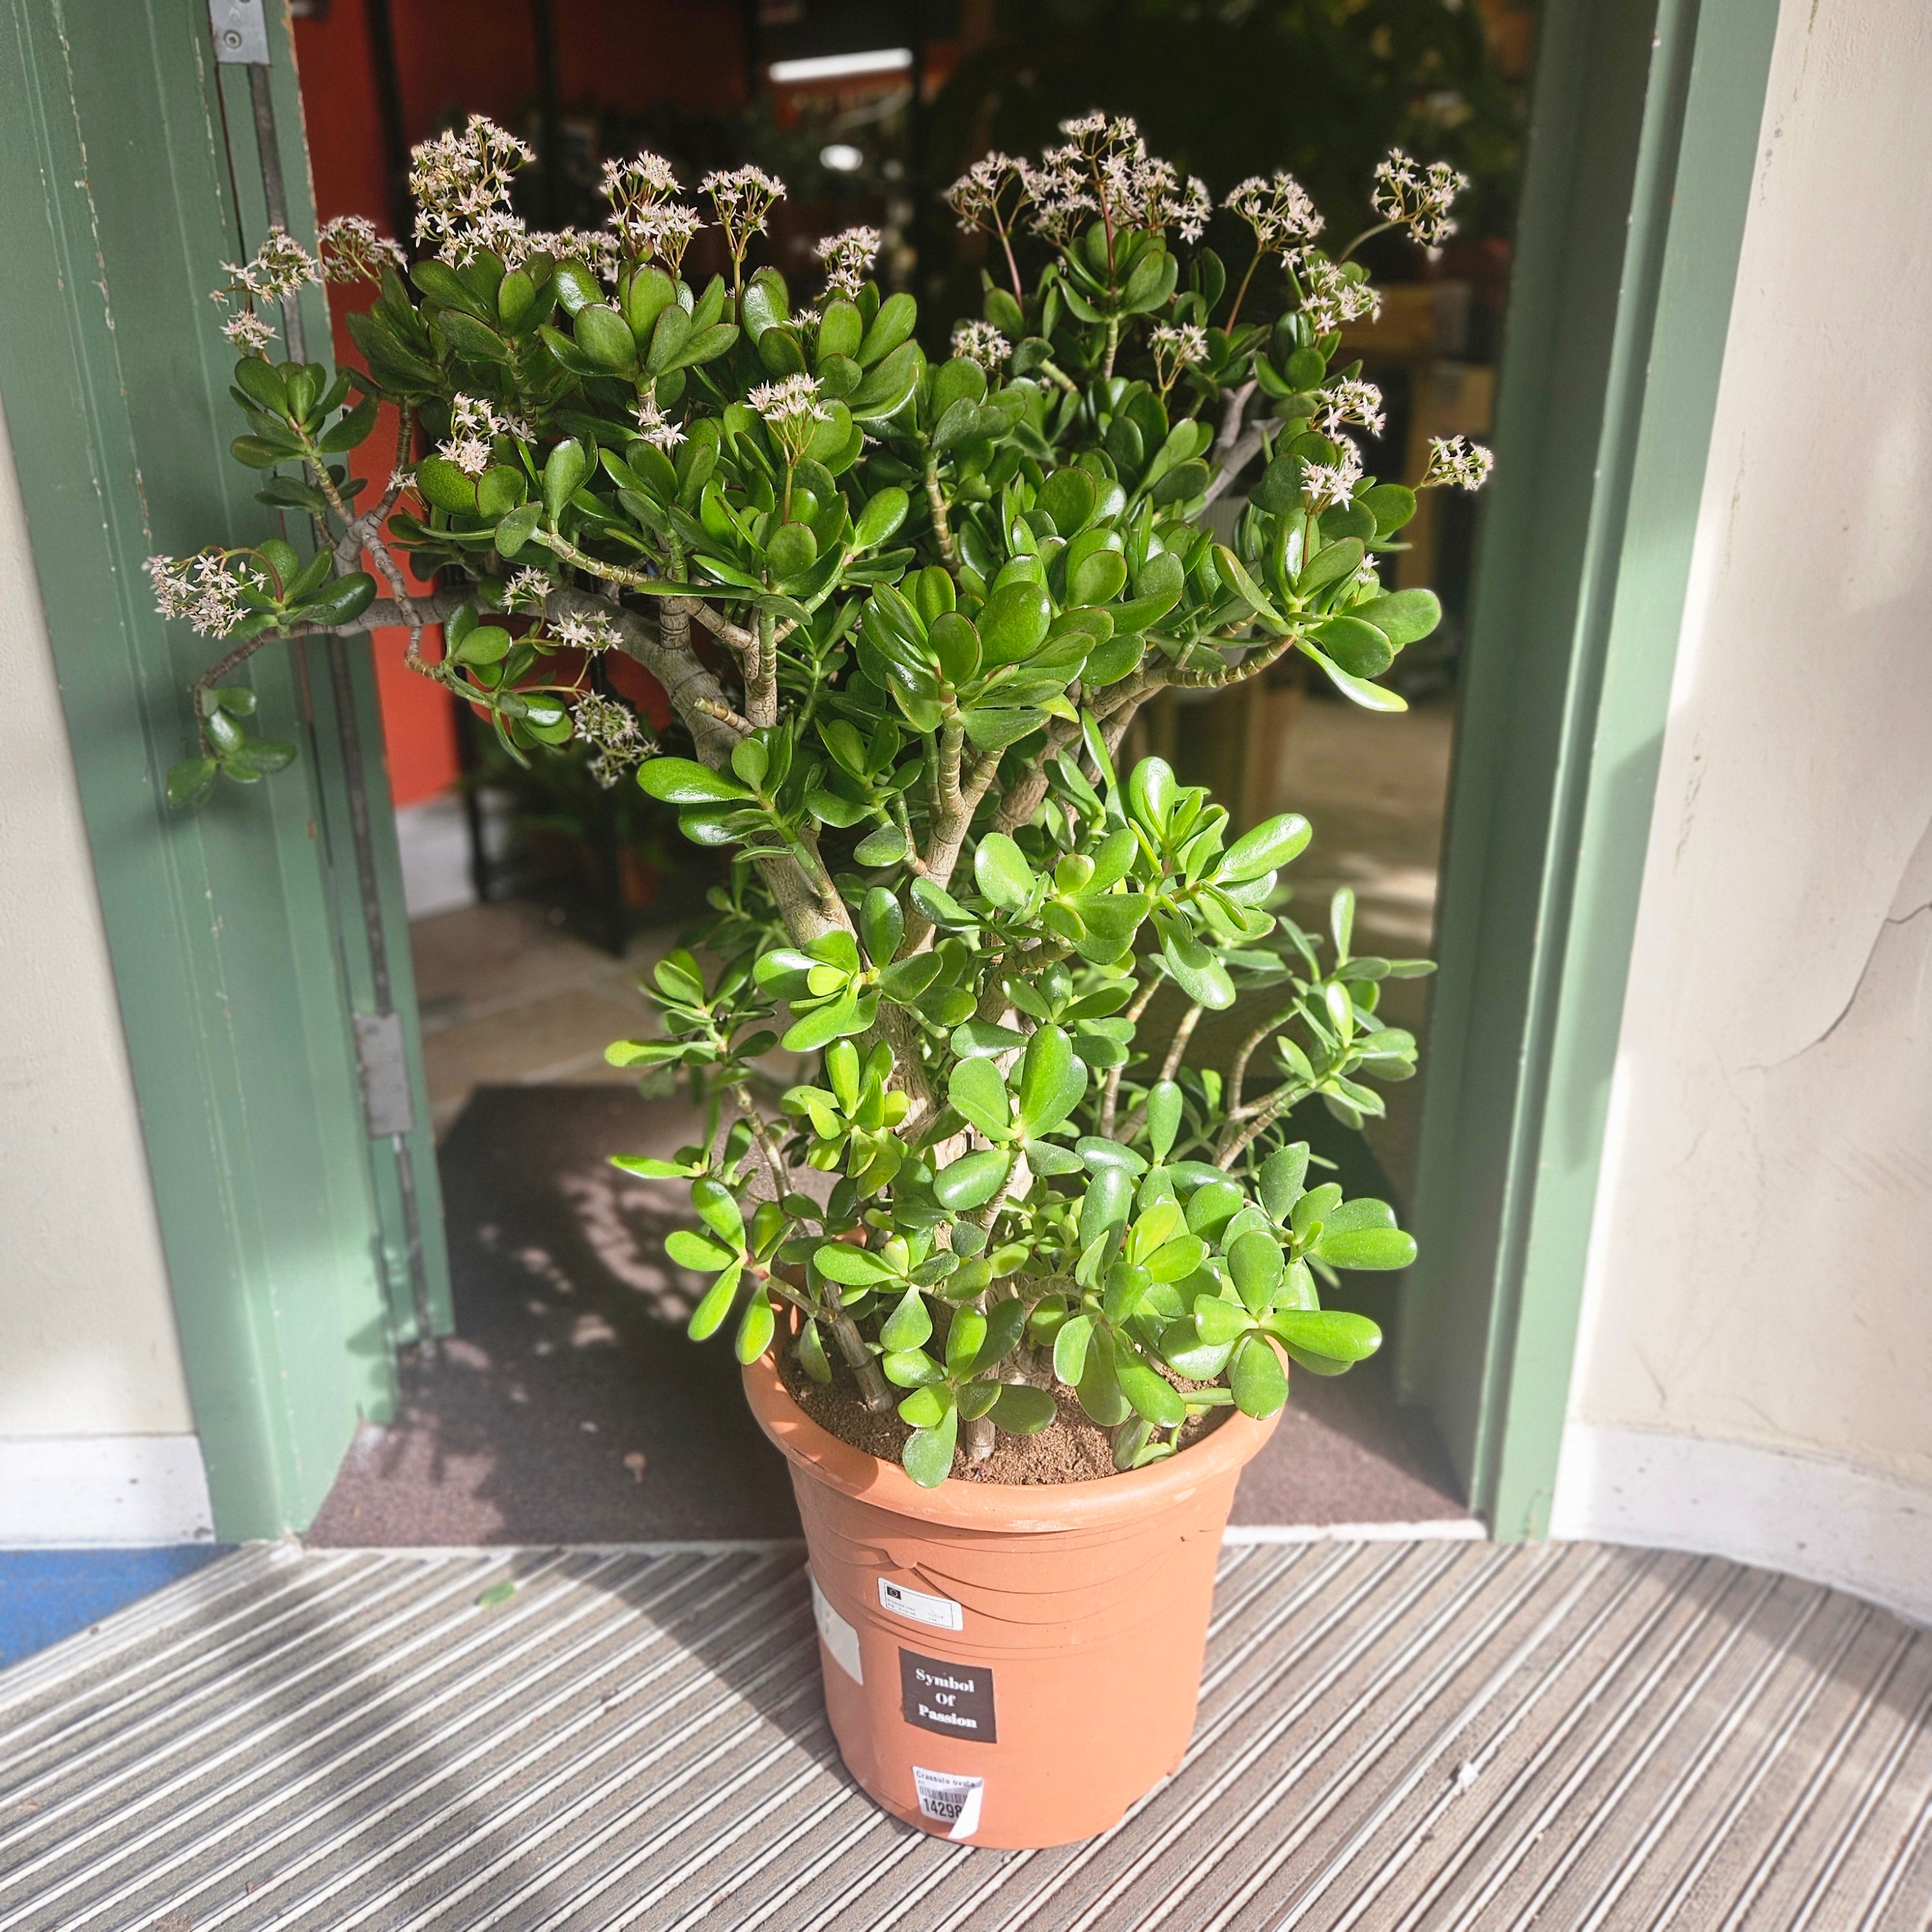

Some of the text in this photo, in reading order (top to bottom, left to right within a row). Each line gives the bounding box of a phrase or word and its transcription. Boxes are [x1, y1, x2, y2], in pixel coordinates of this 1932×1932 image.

[916, 1668, 974, 1692] Symbol
[935, 1692, 956, 1707] Of
[918, 1703, 978, 1729] Passion
[916, 1770, 950, 1784] Crassula
